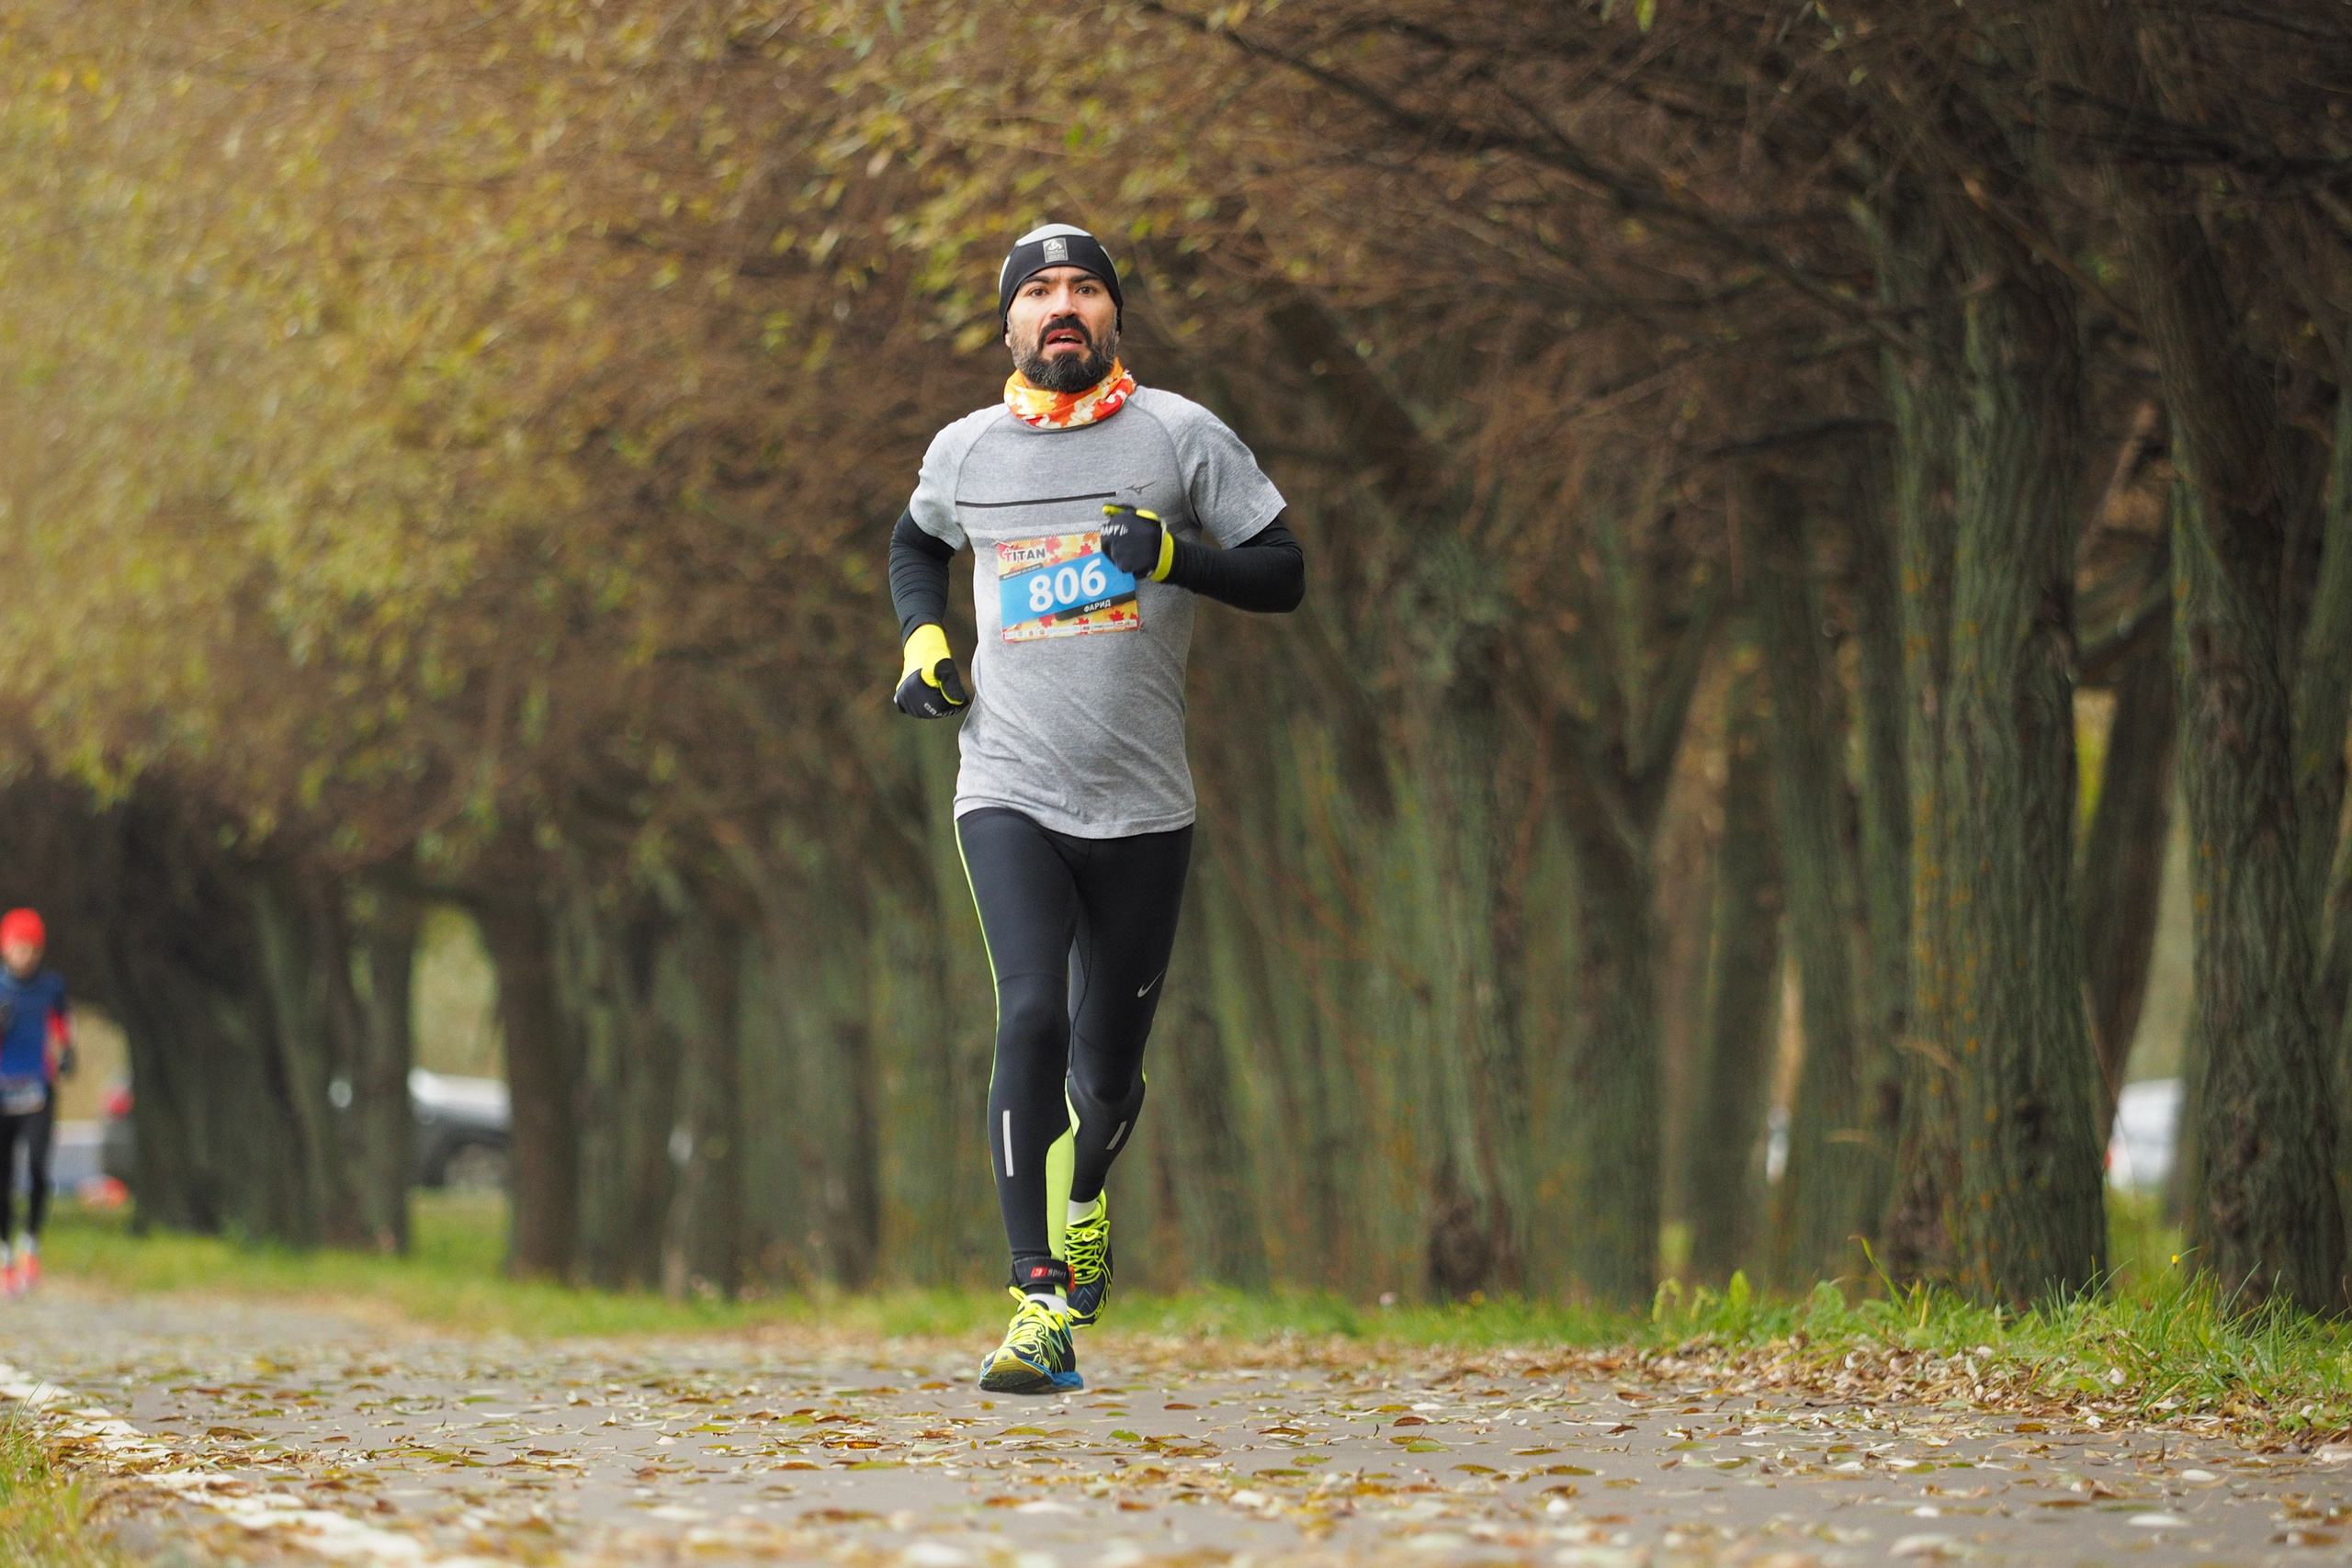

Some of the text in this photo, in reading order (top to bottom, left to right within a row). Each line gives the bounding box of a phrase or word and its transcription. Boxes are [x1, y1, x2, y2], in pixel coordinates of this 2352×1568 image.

[1003, 548, 1046, 562] TITAN
[1029, 558, 1106, 612] 806
[1083, 599, 1112, 613] ФАРИД
